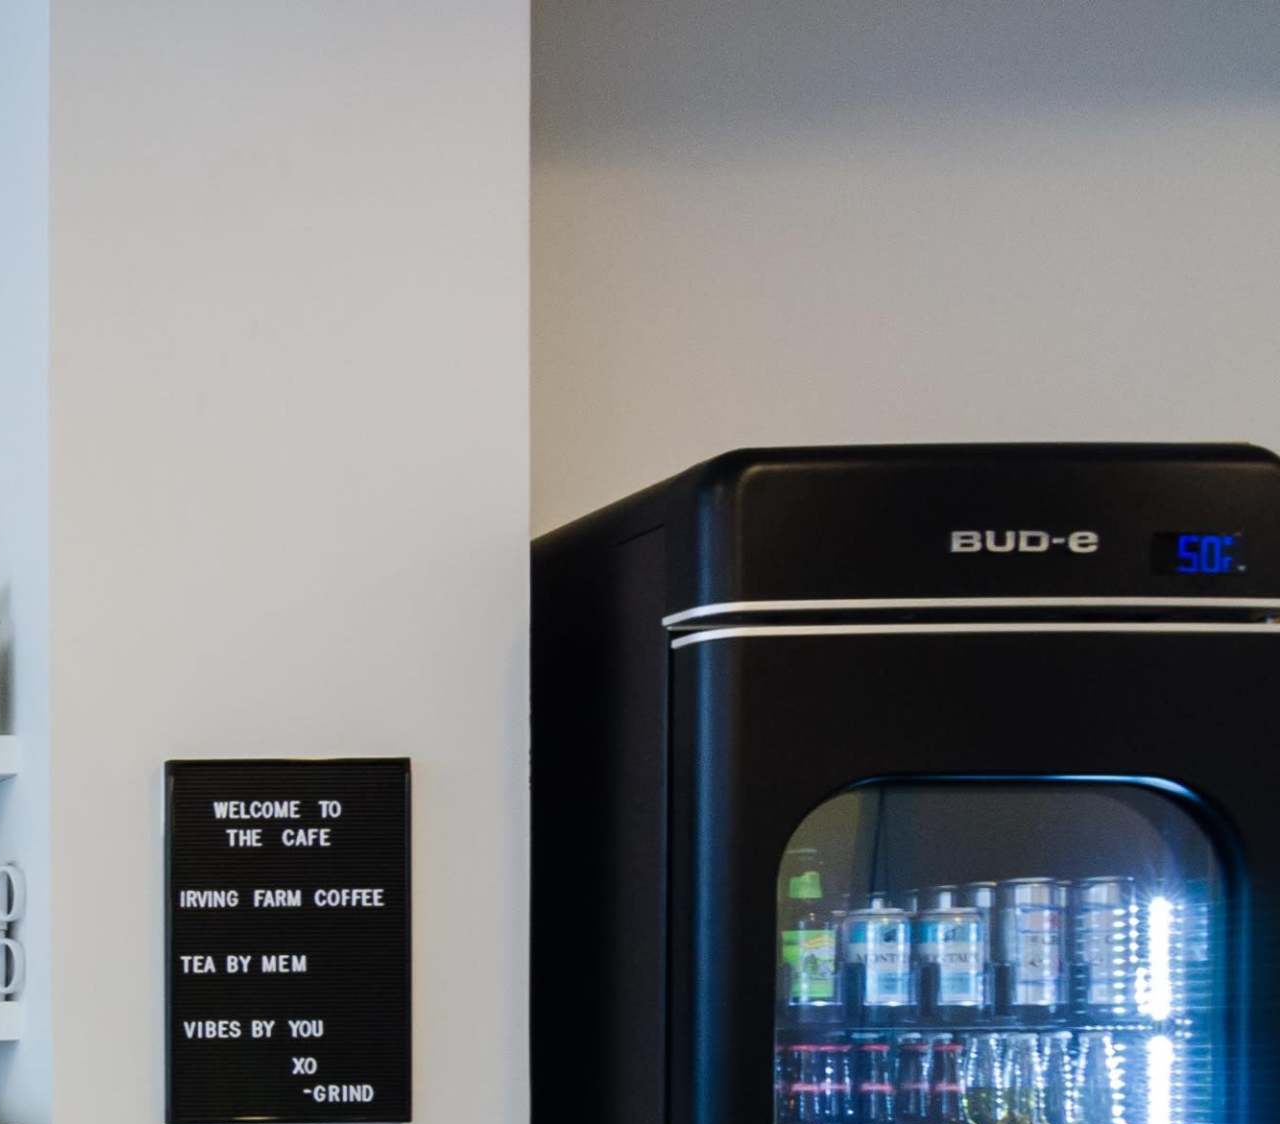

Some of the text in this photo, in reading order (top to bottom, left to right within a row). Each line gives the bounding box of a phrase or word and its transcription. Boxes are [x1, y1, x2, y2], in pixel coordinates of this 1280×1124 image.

[214, 801, 341, 818] WELCOME TO
[226, 829, 330, 846] THE CAFE
[181, 889, 384, 907] IRVING FARM COFFEE
[181, 955, 306, 973] TEA BY MEM
[184, 1020, 323, 1038] VIBES BY YOU
[293, 1058, 317, 1074] XO
[304, 1085, 373, 1102] -GRIND
